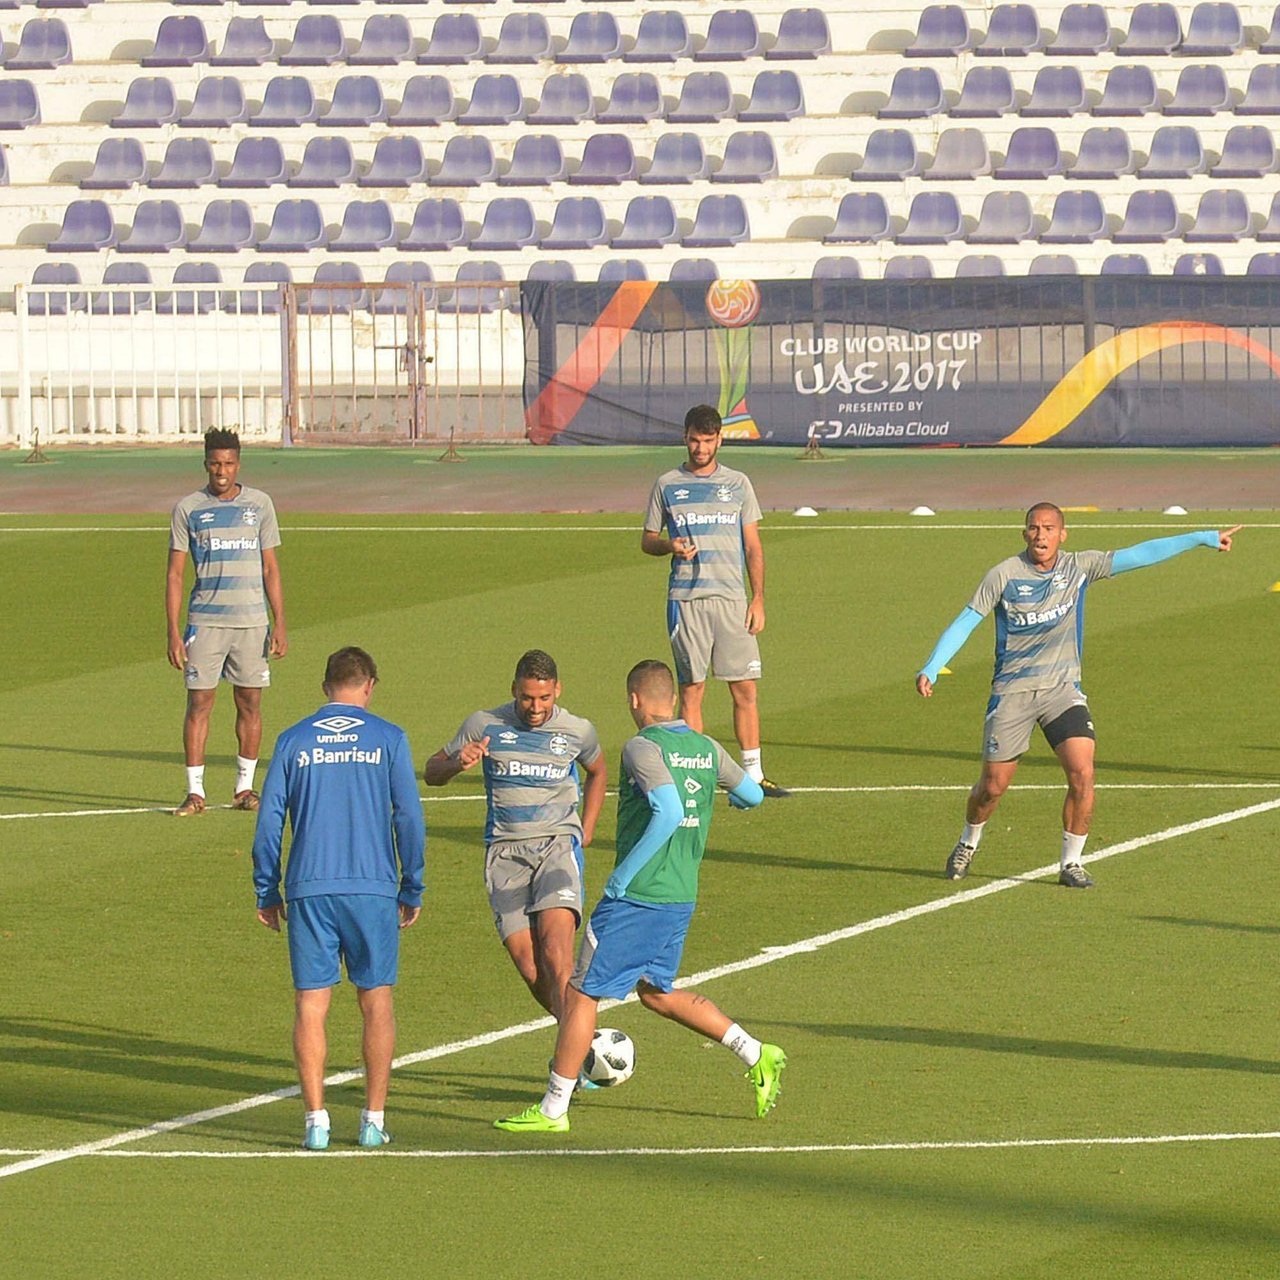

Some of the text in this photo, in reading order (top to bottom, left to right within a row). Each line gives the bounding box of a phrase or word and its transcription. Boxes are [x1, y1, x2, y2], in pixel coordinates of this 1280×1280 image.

[780, 332, 982, 356] CLUB WORLD CUP
[794, 358, 968, 395] UAE 2017
[838, 401, 923, 413] PRESENTED BY
[844, 421, 949, 438] Alibaba Cloud
[316, 733, 358, 743] umbro
[312, 746, 382, 765] Banrisul
